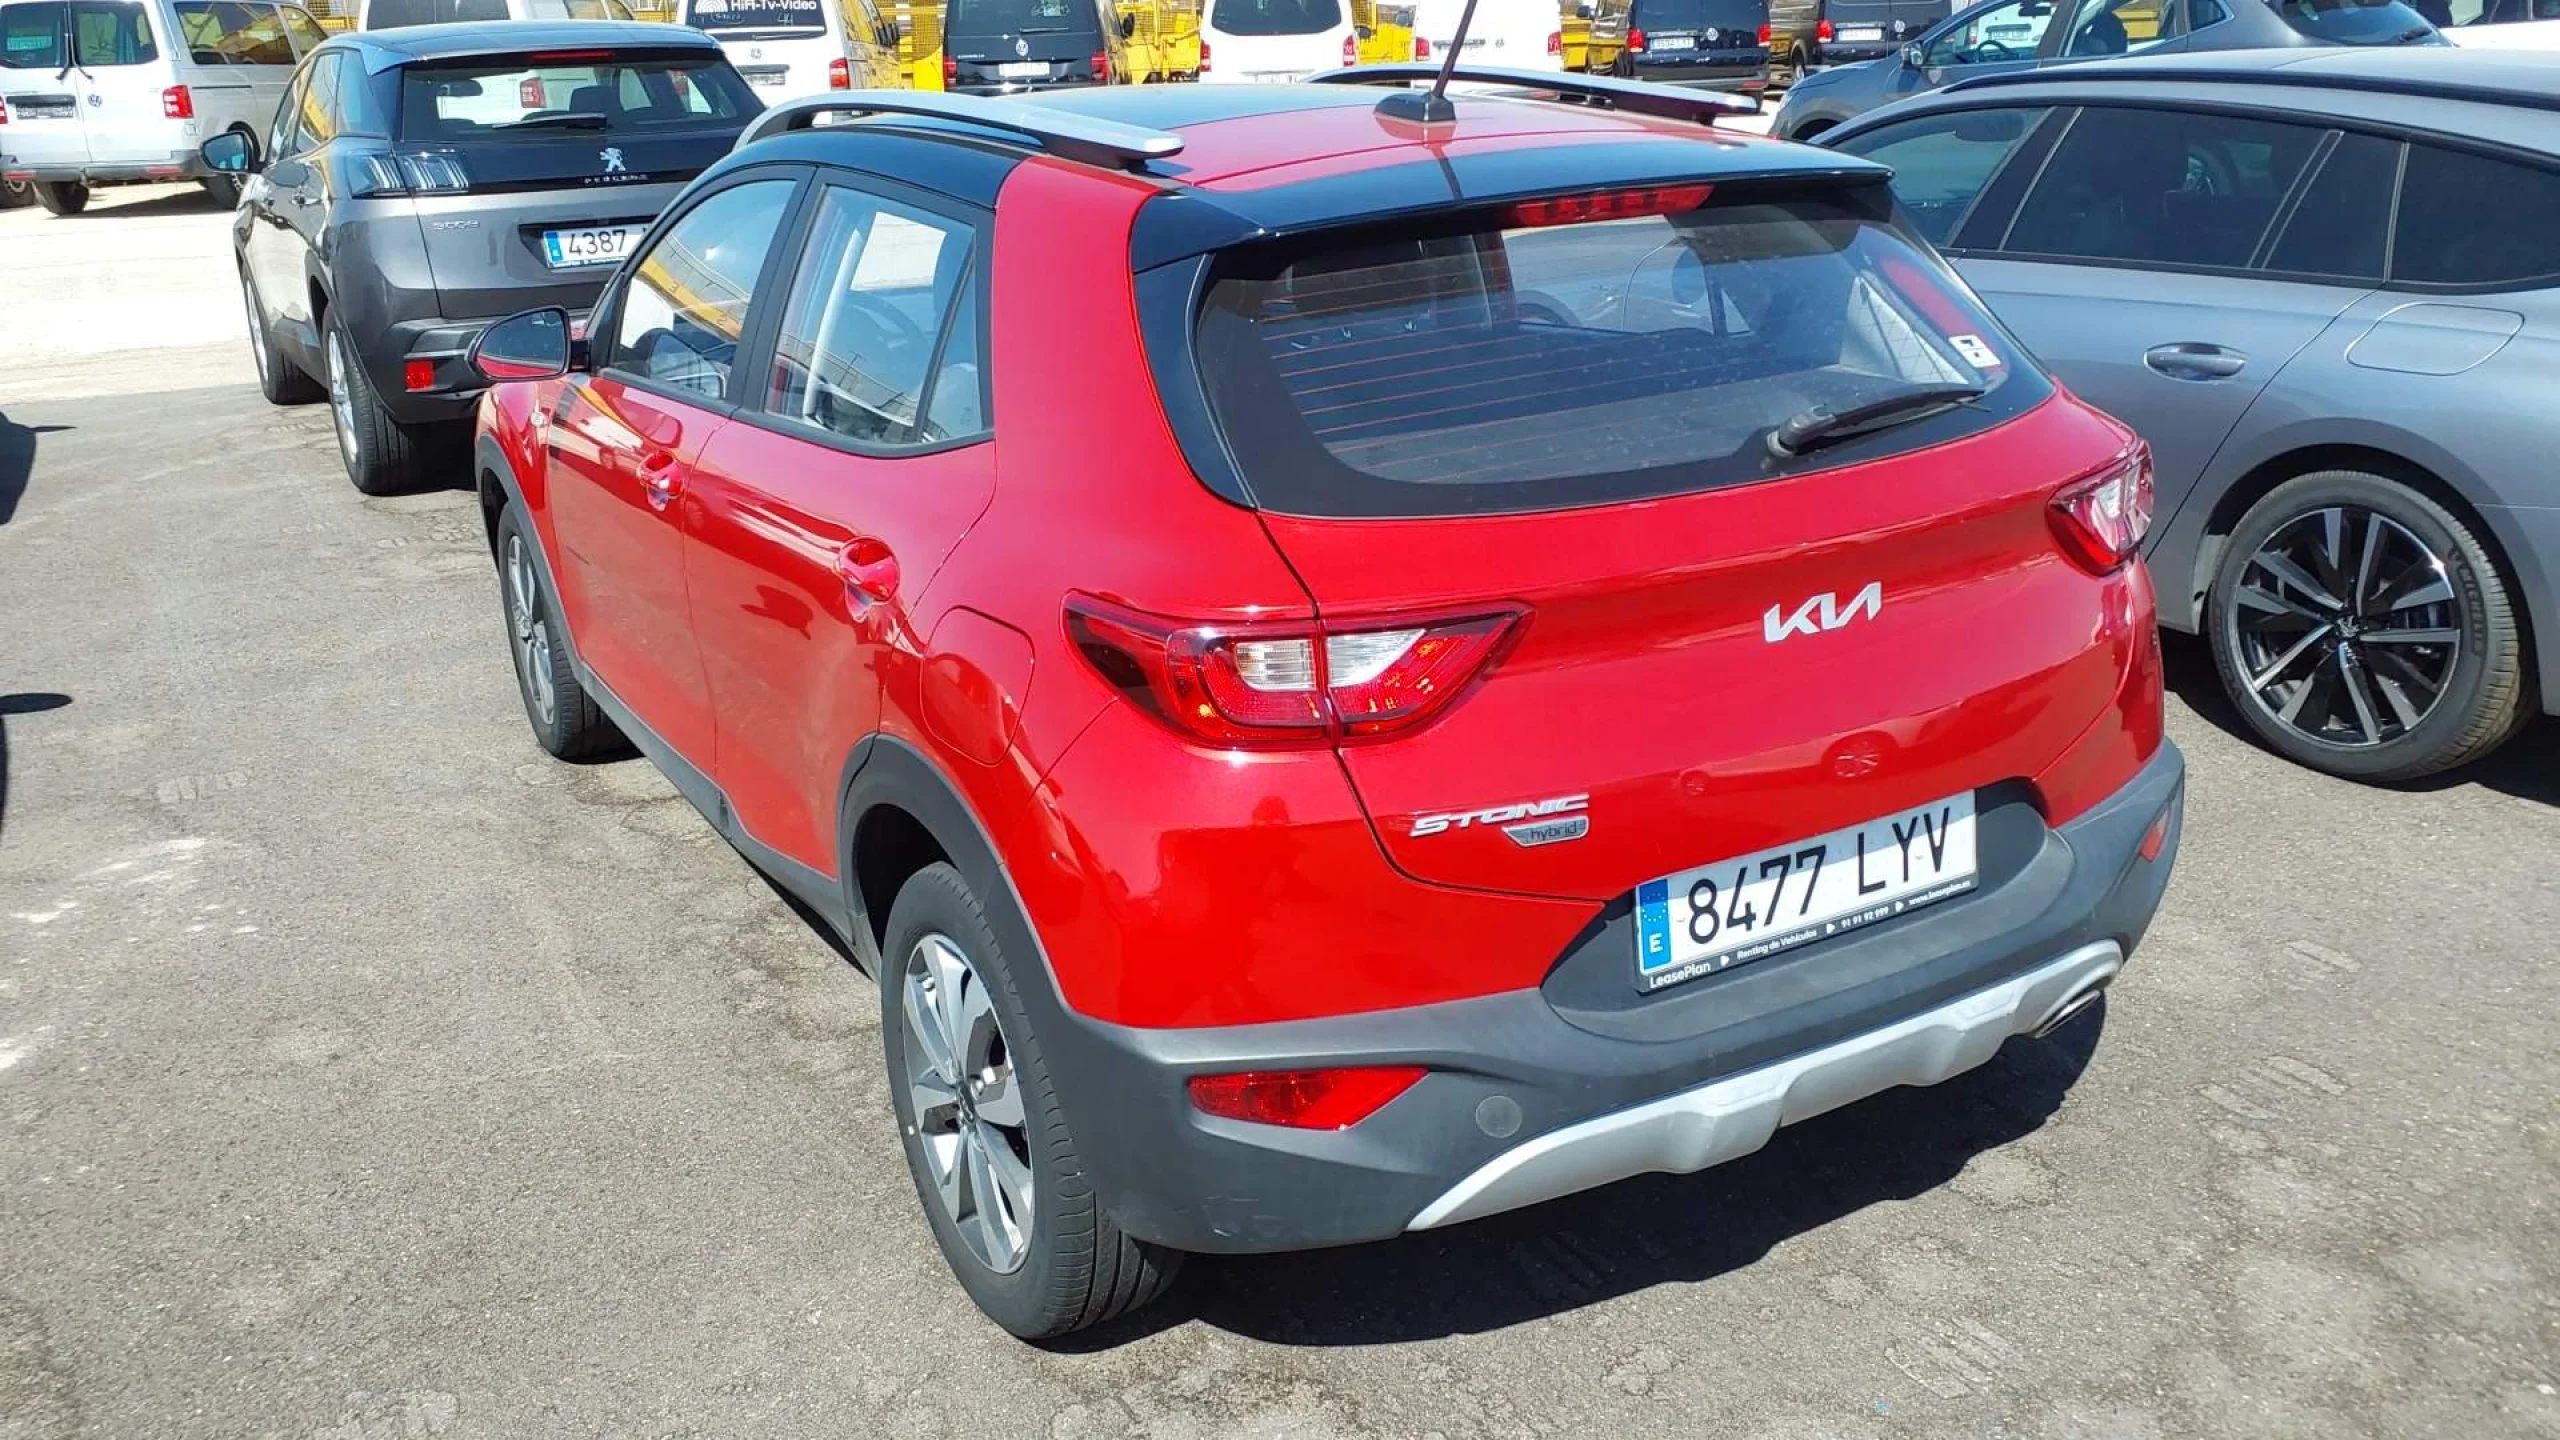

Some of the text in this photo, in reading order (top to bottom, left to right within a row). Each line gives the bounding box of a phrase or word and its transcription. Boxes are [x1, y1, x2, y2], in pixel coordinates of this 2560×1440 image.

[569, 228, 627, 256] 4387
[1763, 581, 1882, 643] KIA
[1410, 794, 1590, 836] STONIC
[1530, 821, 1578, 841] hybrid
[1687, 806, 1951, 945] 8477 LYV
[1648, 931, 1663, 953] E
[1737, 941, 1769, 960] Renting
[1649, 961, 1711, 989] LeasePlan
